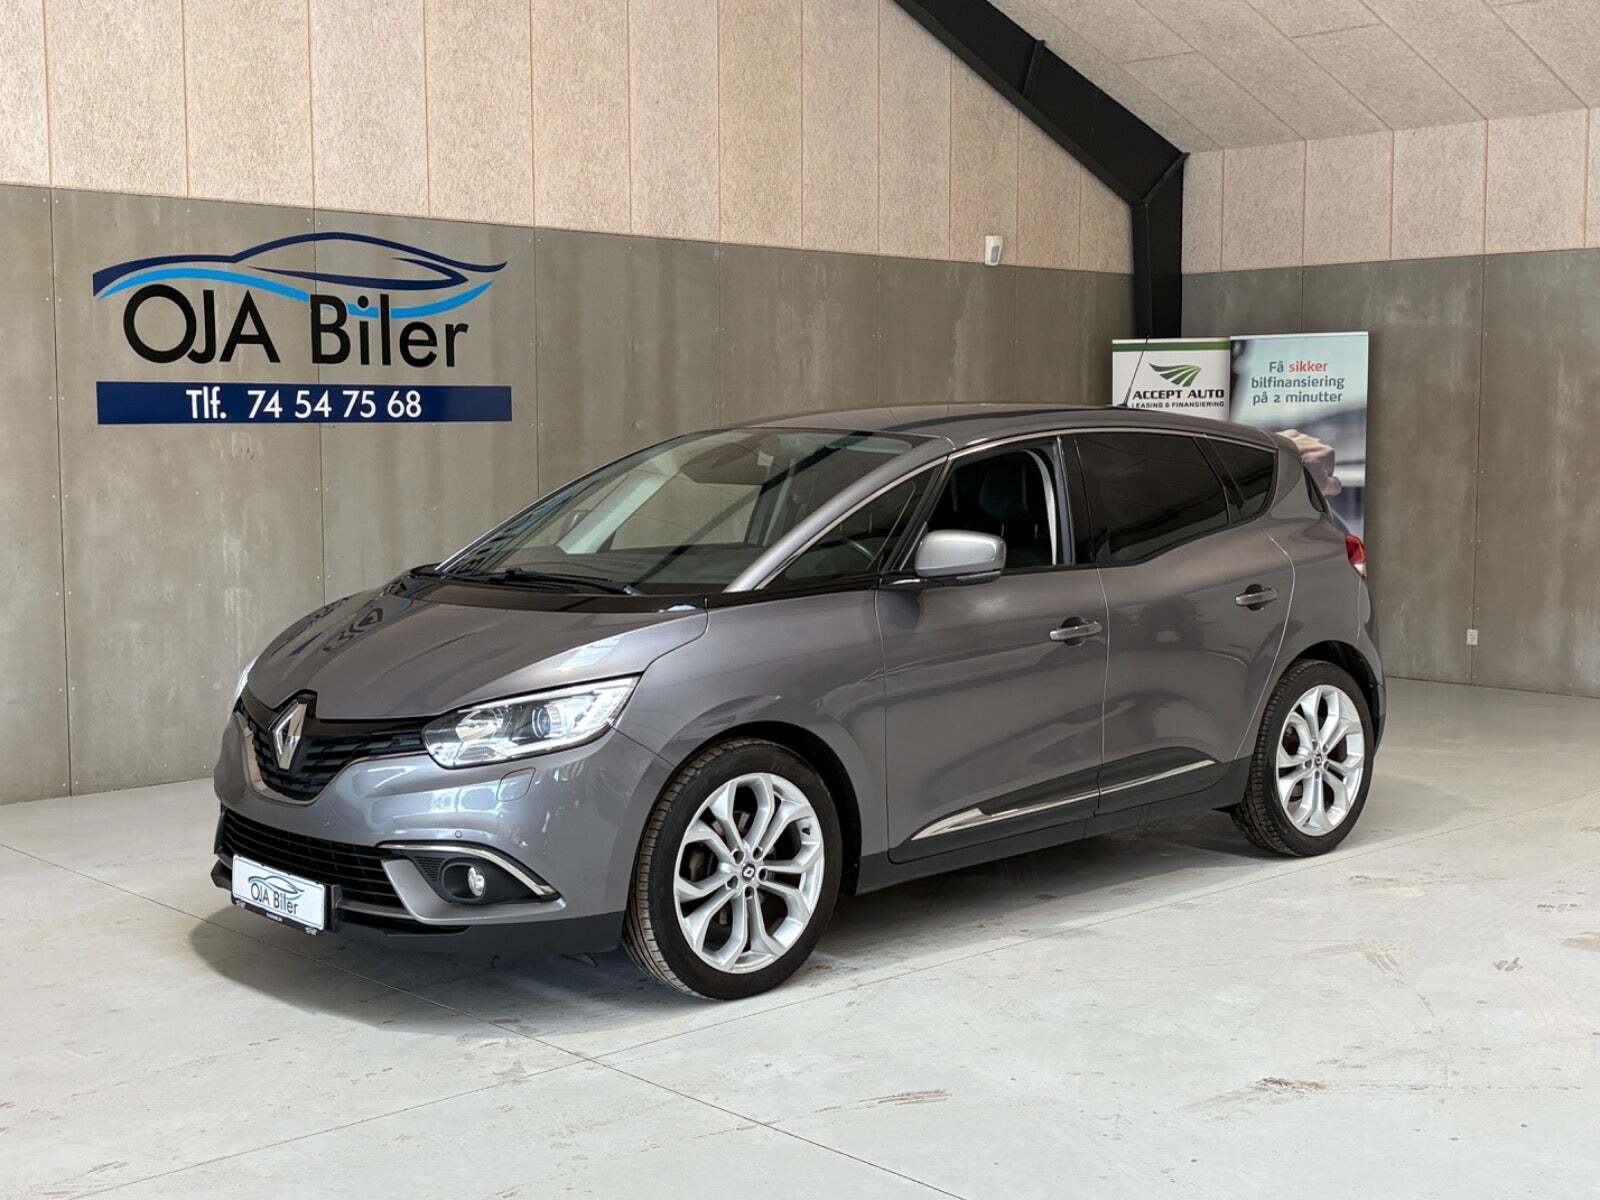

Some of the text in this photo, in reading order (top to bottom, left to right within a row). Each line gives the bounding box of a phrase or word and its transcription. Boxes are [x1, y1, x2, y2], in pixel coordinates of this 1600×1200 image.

[123, 284, 469, 367] OJA Biler
[1268, 360, 1329, 373] Få sikker
[1251, 376, 1345, 390] bilfinansiering
[1132, 388, 1225, 400] ACCEPT AUTO
[1252, 391, 1343, 405] på 2 minutter
[186, 386, 422, 419] Tlf. 74 54 75 68
[251, 883, 298, 914] OJA Biler
